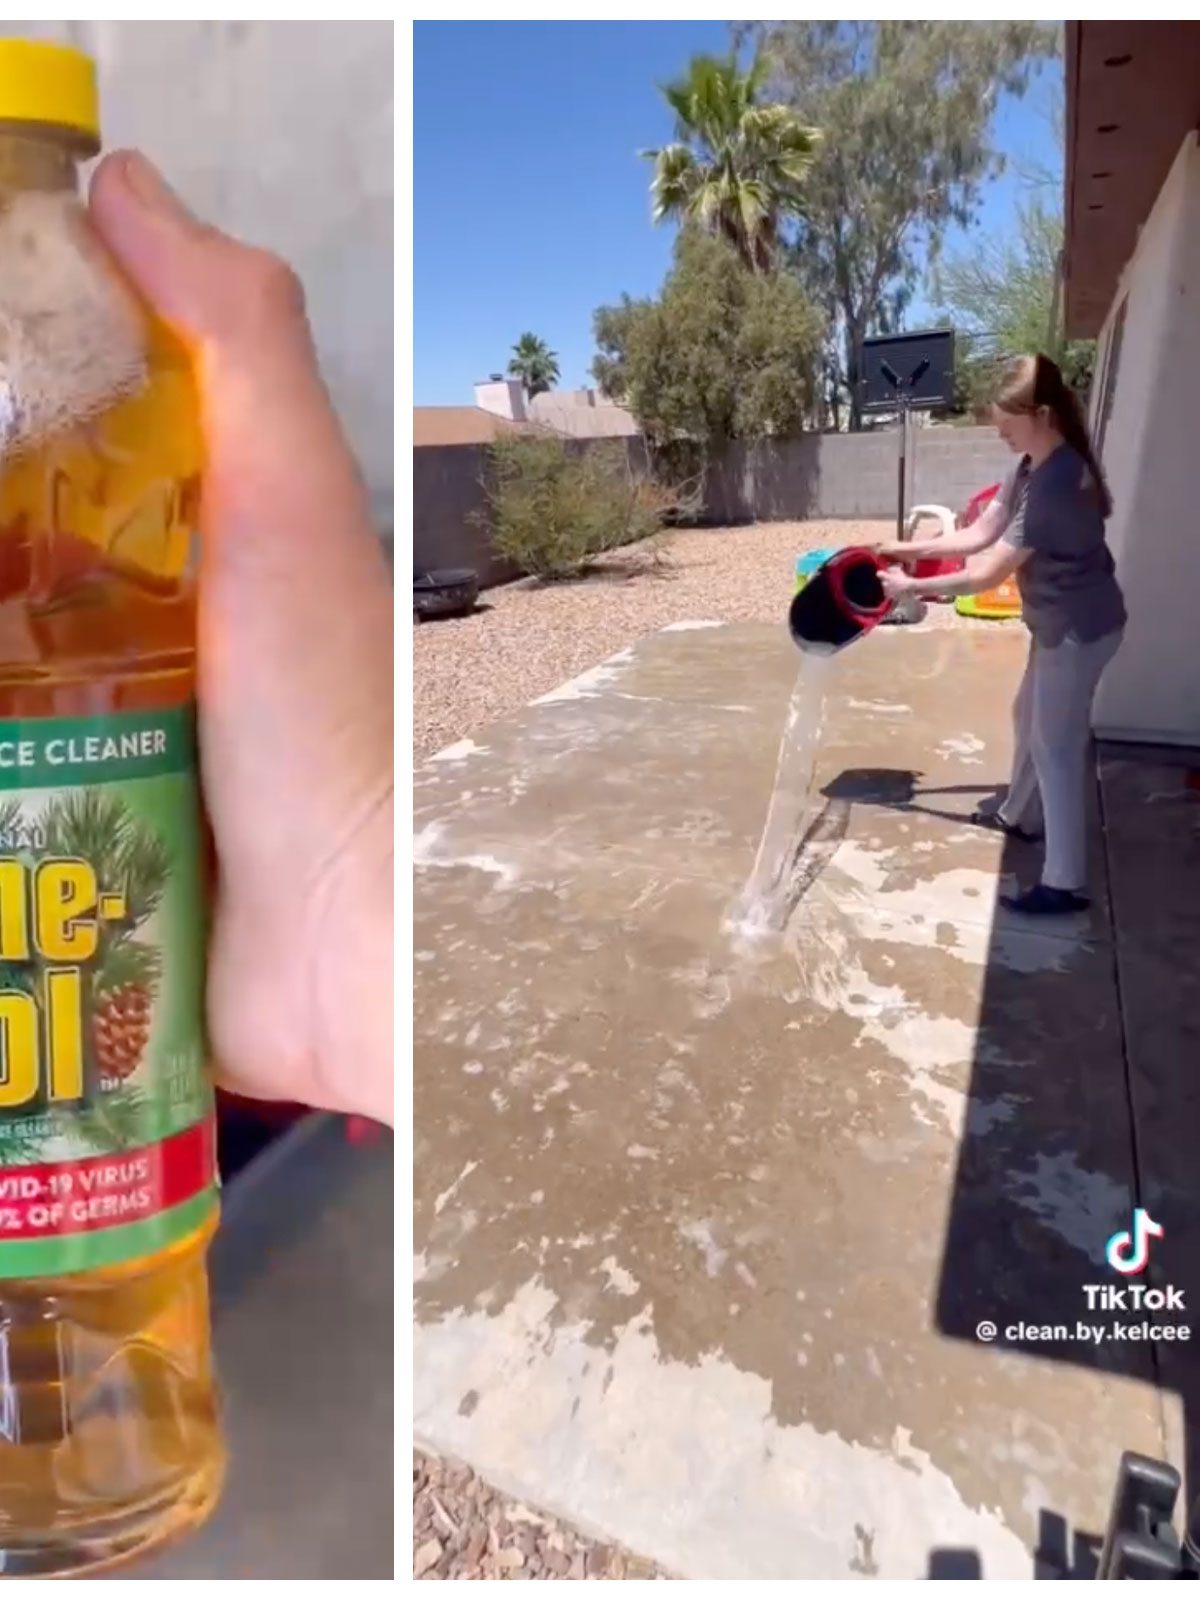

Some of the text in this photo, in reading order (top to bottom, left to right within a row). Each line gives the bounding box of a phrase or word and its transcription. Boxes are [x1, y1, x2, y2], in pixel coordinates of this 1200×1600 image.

[44, 729, 167, 765] CLEANER
[78, 1157, 148, 1191] VIRUS
[27, 1203, 63, 1228] OF
[68, 1188, 151, 1222] GERMS
